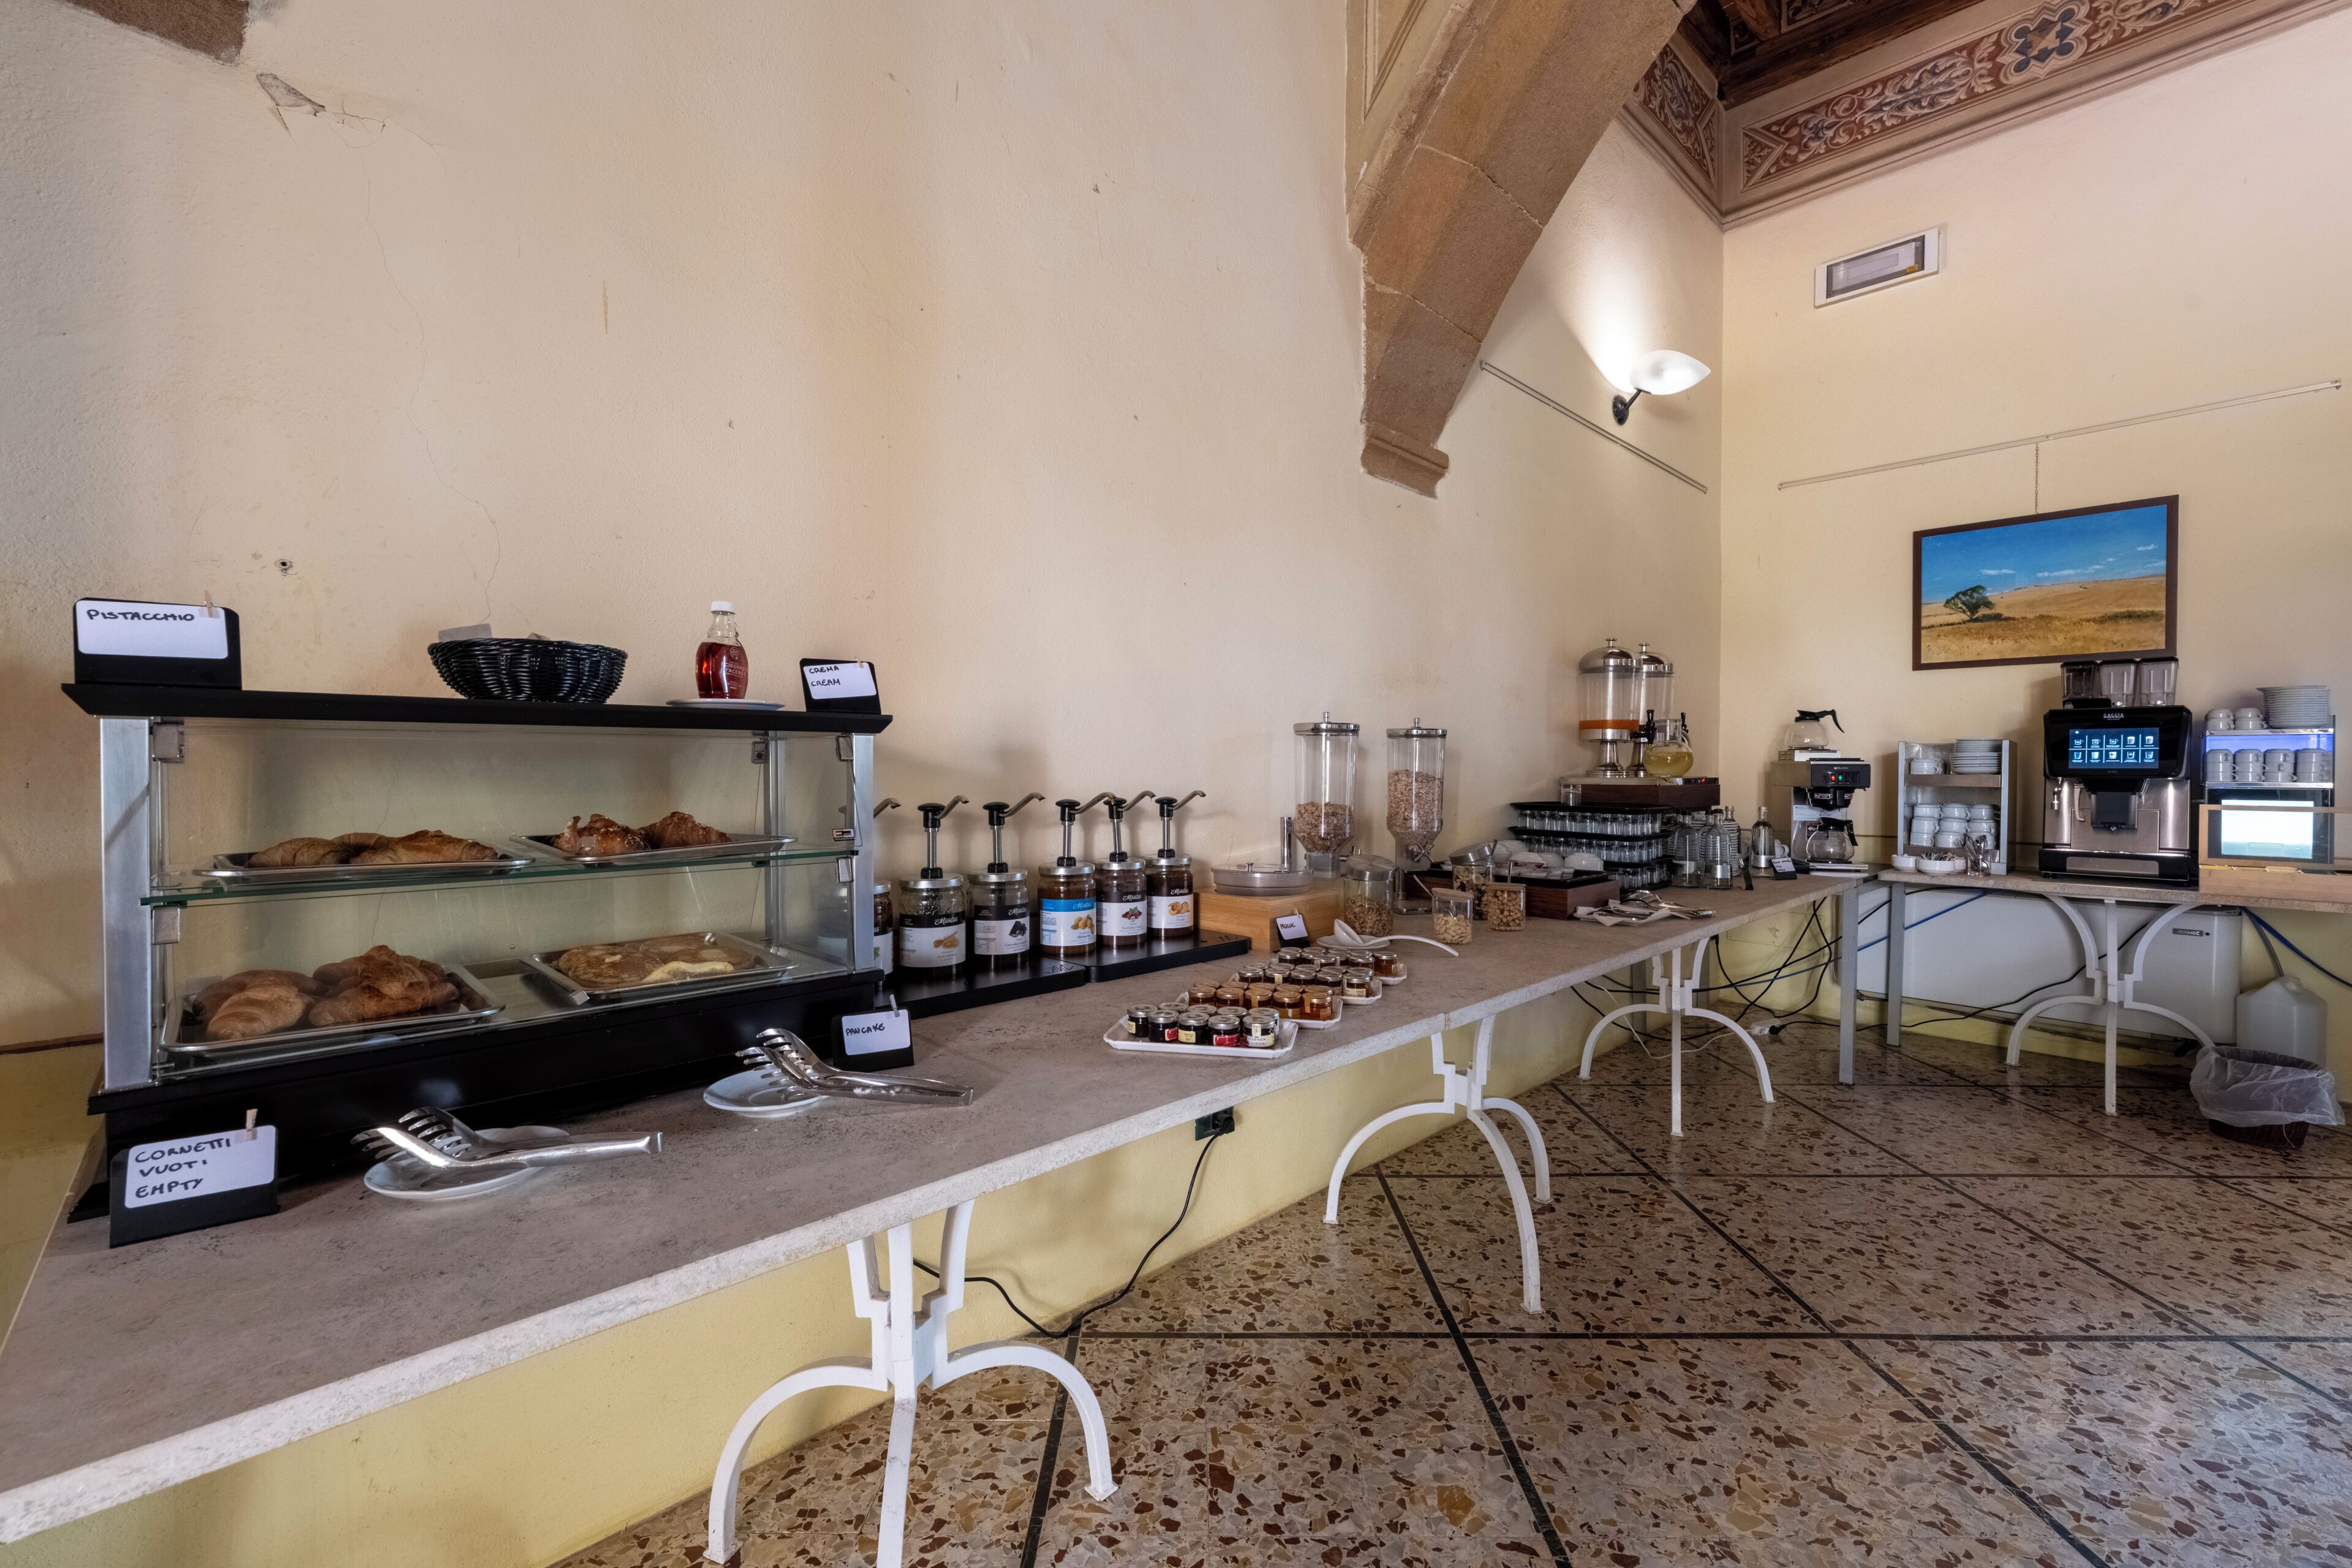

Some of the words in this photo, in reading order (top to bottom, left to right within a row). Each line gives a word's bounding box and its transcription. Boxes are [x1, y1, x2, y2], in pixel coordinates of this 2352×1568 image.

[86, 609, 195, 621] PISTACCHIO
[809, 665, 840, 674] CREMA
[135, 1138, 231, 1163] CORNETTI
[139, 1159, 208, 1177] VUOTI
[135, 1178, 203, 1199] EMPTY
